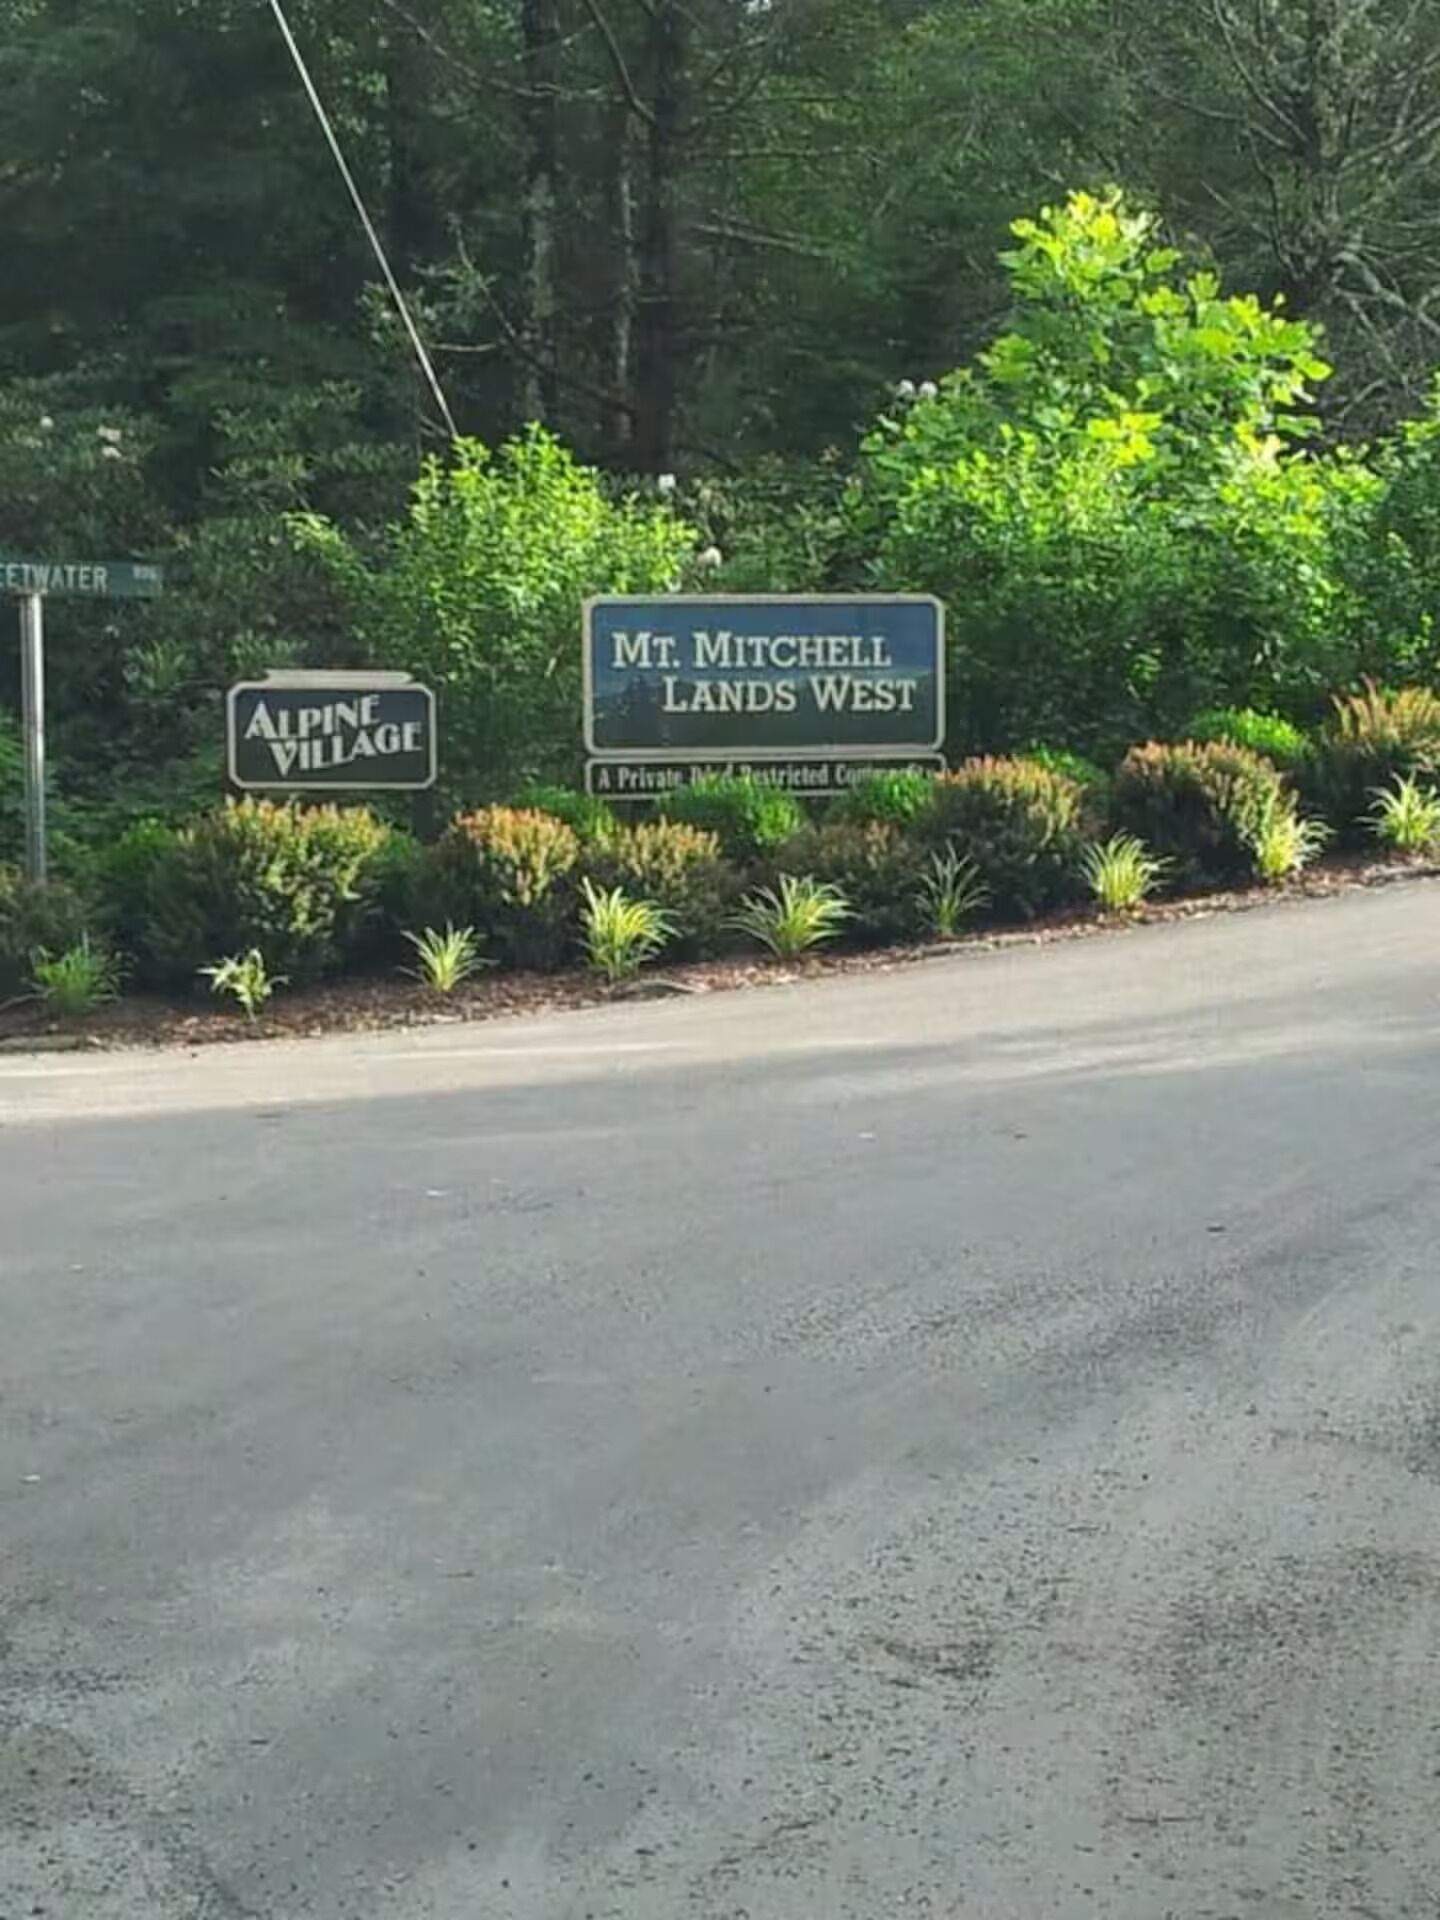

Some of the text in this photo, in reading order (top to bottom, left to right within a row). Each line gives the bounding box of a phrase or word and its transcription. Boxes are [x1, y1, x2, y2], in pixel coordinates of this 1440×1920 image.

[611, 631, 892, 669] MT. MITCHELL
[662, 674, 917, 713] LANDS WEST
[244, 694, 381, 741] ALPINE
[270, 721, 423, 778] VILLAGE
[600, 767, 611, 789] A
